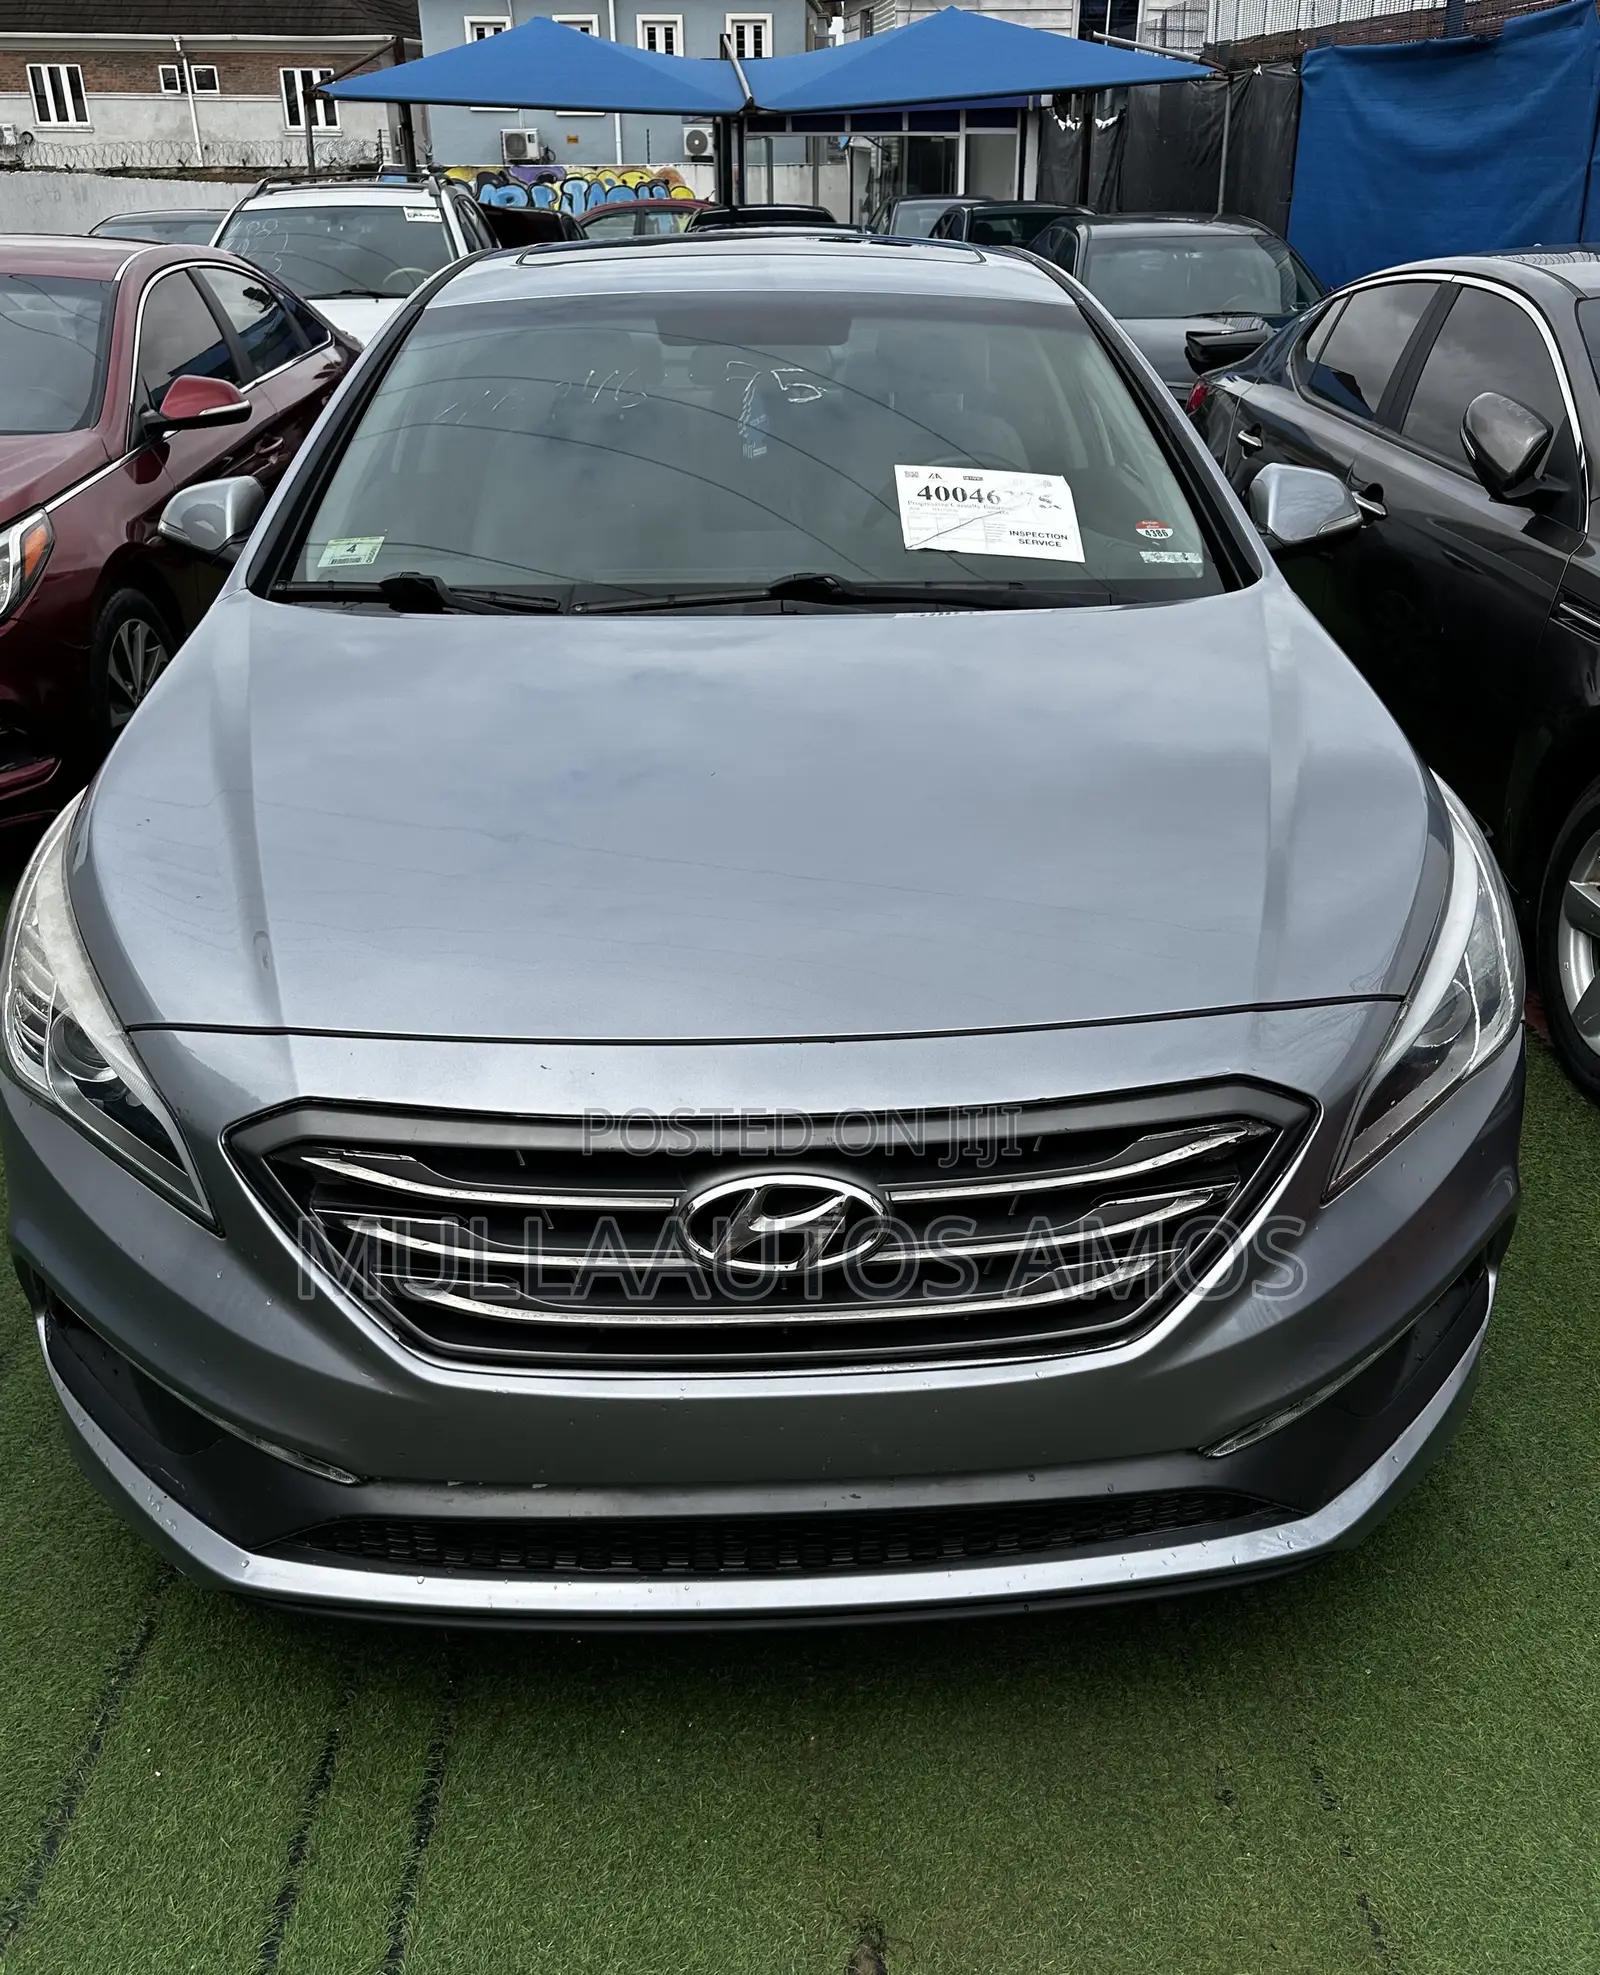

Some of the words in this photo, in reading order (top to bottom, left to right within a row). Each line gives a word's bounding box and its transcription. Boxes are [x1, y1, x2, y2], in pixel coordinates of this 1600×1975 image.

[1009, 530, 1068, 540] INSPECTION
[1145, 529, 1169, 537] 4386
[1018, 538, 1062, 547] SERVICE
[346, 544, 357, 553] 4
